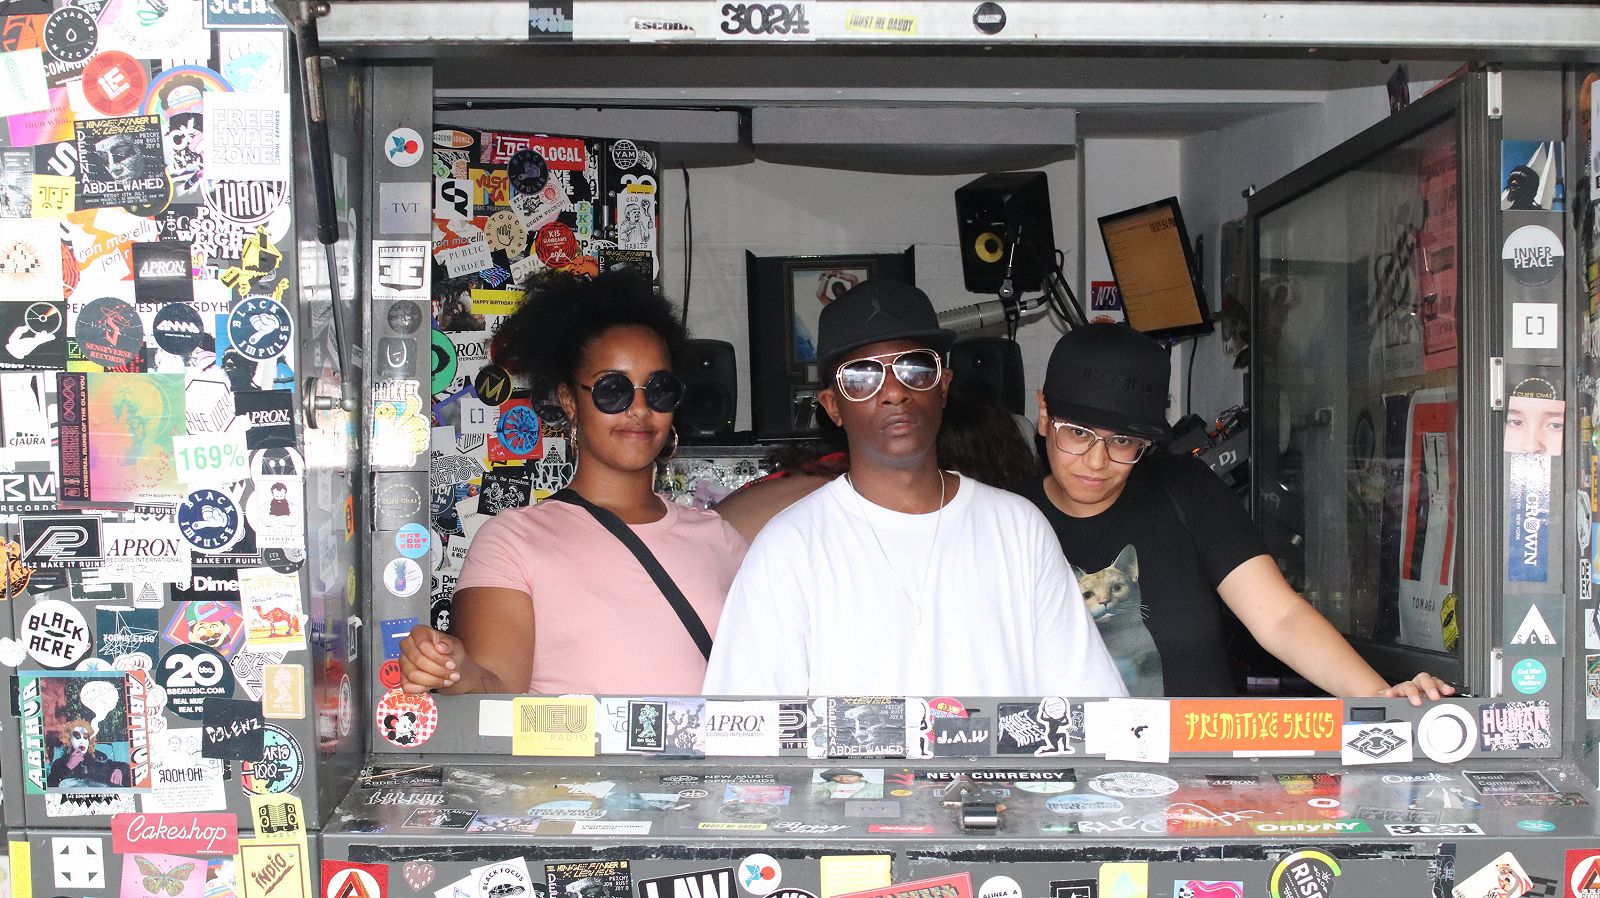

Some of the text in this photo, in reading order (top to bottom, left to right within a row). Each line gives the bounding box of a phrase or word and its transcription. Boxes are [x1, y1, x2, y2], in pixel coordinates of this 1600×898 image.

[48, 11, 94, 35] PENSADOR
[720, 3, 810, 34] 3024
[850, 15, 913, 31] TRUST ME DADDY
[52, 41, 94, 59] MEZCAL
[213, 109, 273, 127] FREE
[213, 128, 273, 145] HYPE
[83, 178, 164, 194] ABDELWAHED
[391, 203, 421, 213] TVT
[526, 213, 544, 228] GEGEN
[452, 231, 485, 245] morelli
[625, 242, 648, 250] HABITS
[449, 244, 485, 260] PUBLIC
[1514, 246, 1552, 258] INNER
[454, 259, 486, 274] ORDER
[1513, 256, 1554, 269] PEACE
[1096, 286, 1118, 306] NTS
[232, 301, 280, 329] BLACK
[238, 325, 290, 358] IMPULSE
[85, 342, 133, 359] SENSEVERSE
[90, 350, 126, 366] RECORDS
[374, 382, 416, 400] ROCKET
[245, 409, 290, 423] PRON.
[81, 422, 87, 433] OF
[179, 443, 245, 471] 169%
[1219, 449, 1237, 467] DJ
[82, 455, 90, 498] CATHEDRAL
[138, 506, 176, 515] IT RUINS
[183, 491, 235, 513] BLACK
[181, 521, 234, 547] IMPULSE
[1523, 493, 1541, 566] CROWN
[107, 538, 181, 557] APRON
[22, 561, 37, 569] PLZ
[40, 561, 64, 569] MAKE
[79, 560, 106, 568] RUINS
[196, 557, 262, 565] MAKE IT RUINS
[194, 576, 240, 591] Dime
[1412, 597, 1436, 612] TOMAGA
[28, 612, 84, 642] BLACK
[29, 635, 75, 660] ACRE
[166, 653, 224, 687] 20
[167, 687, 225, 695] BBEMUSIC.COM
[383, 693, 433, 714] VEGYN
[521, 704, 588, 733] NEU
[1000, 709, 1038, 736] GHOST
[1184, 711, 1335, 741] PRIMITIVE SKILLS
[1482, 706, 1551, 734] HUMAN
[21, 677, 47, 791] ARTHUR
[1008, 724, 1047, 748] NOTES
[263, 744, 290, 761] ARIS
[829, 746, 904, 756] ABDELWAHED
[927, 771, 1065, 780] NEW CURRENCY
[1478, 780, 1542, 788] Community
[1482, 785, 1517, 793] Radio
[438, 809, 474, 817] ATLANTIS
[126, 815, 227, 851] Cakeshop
[589, 861, 620, 870] FINGER
[482, 867, 525, 891] BLACK FOCUS
